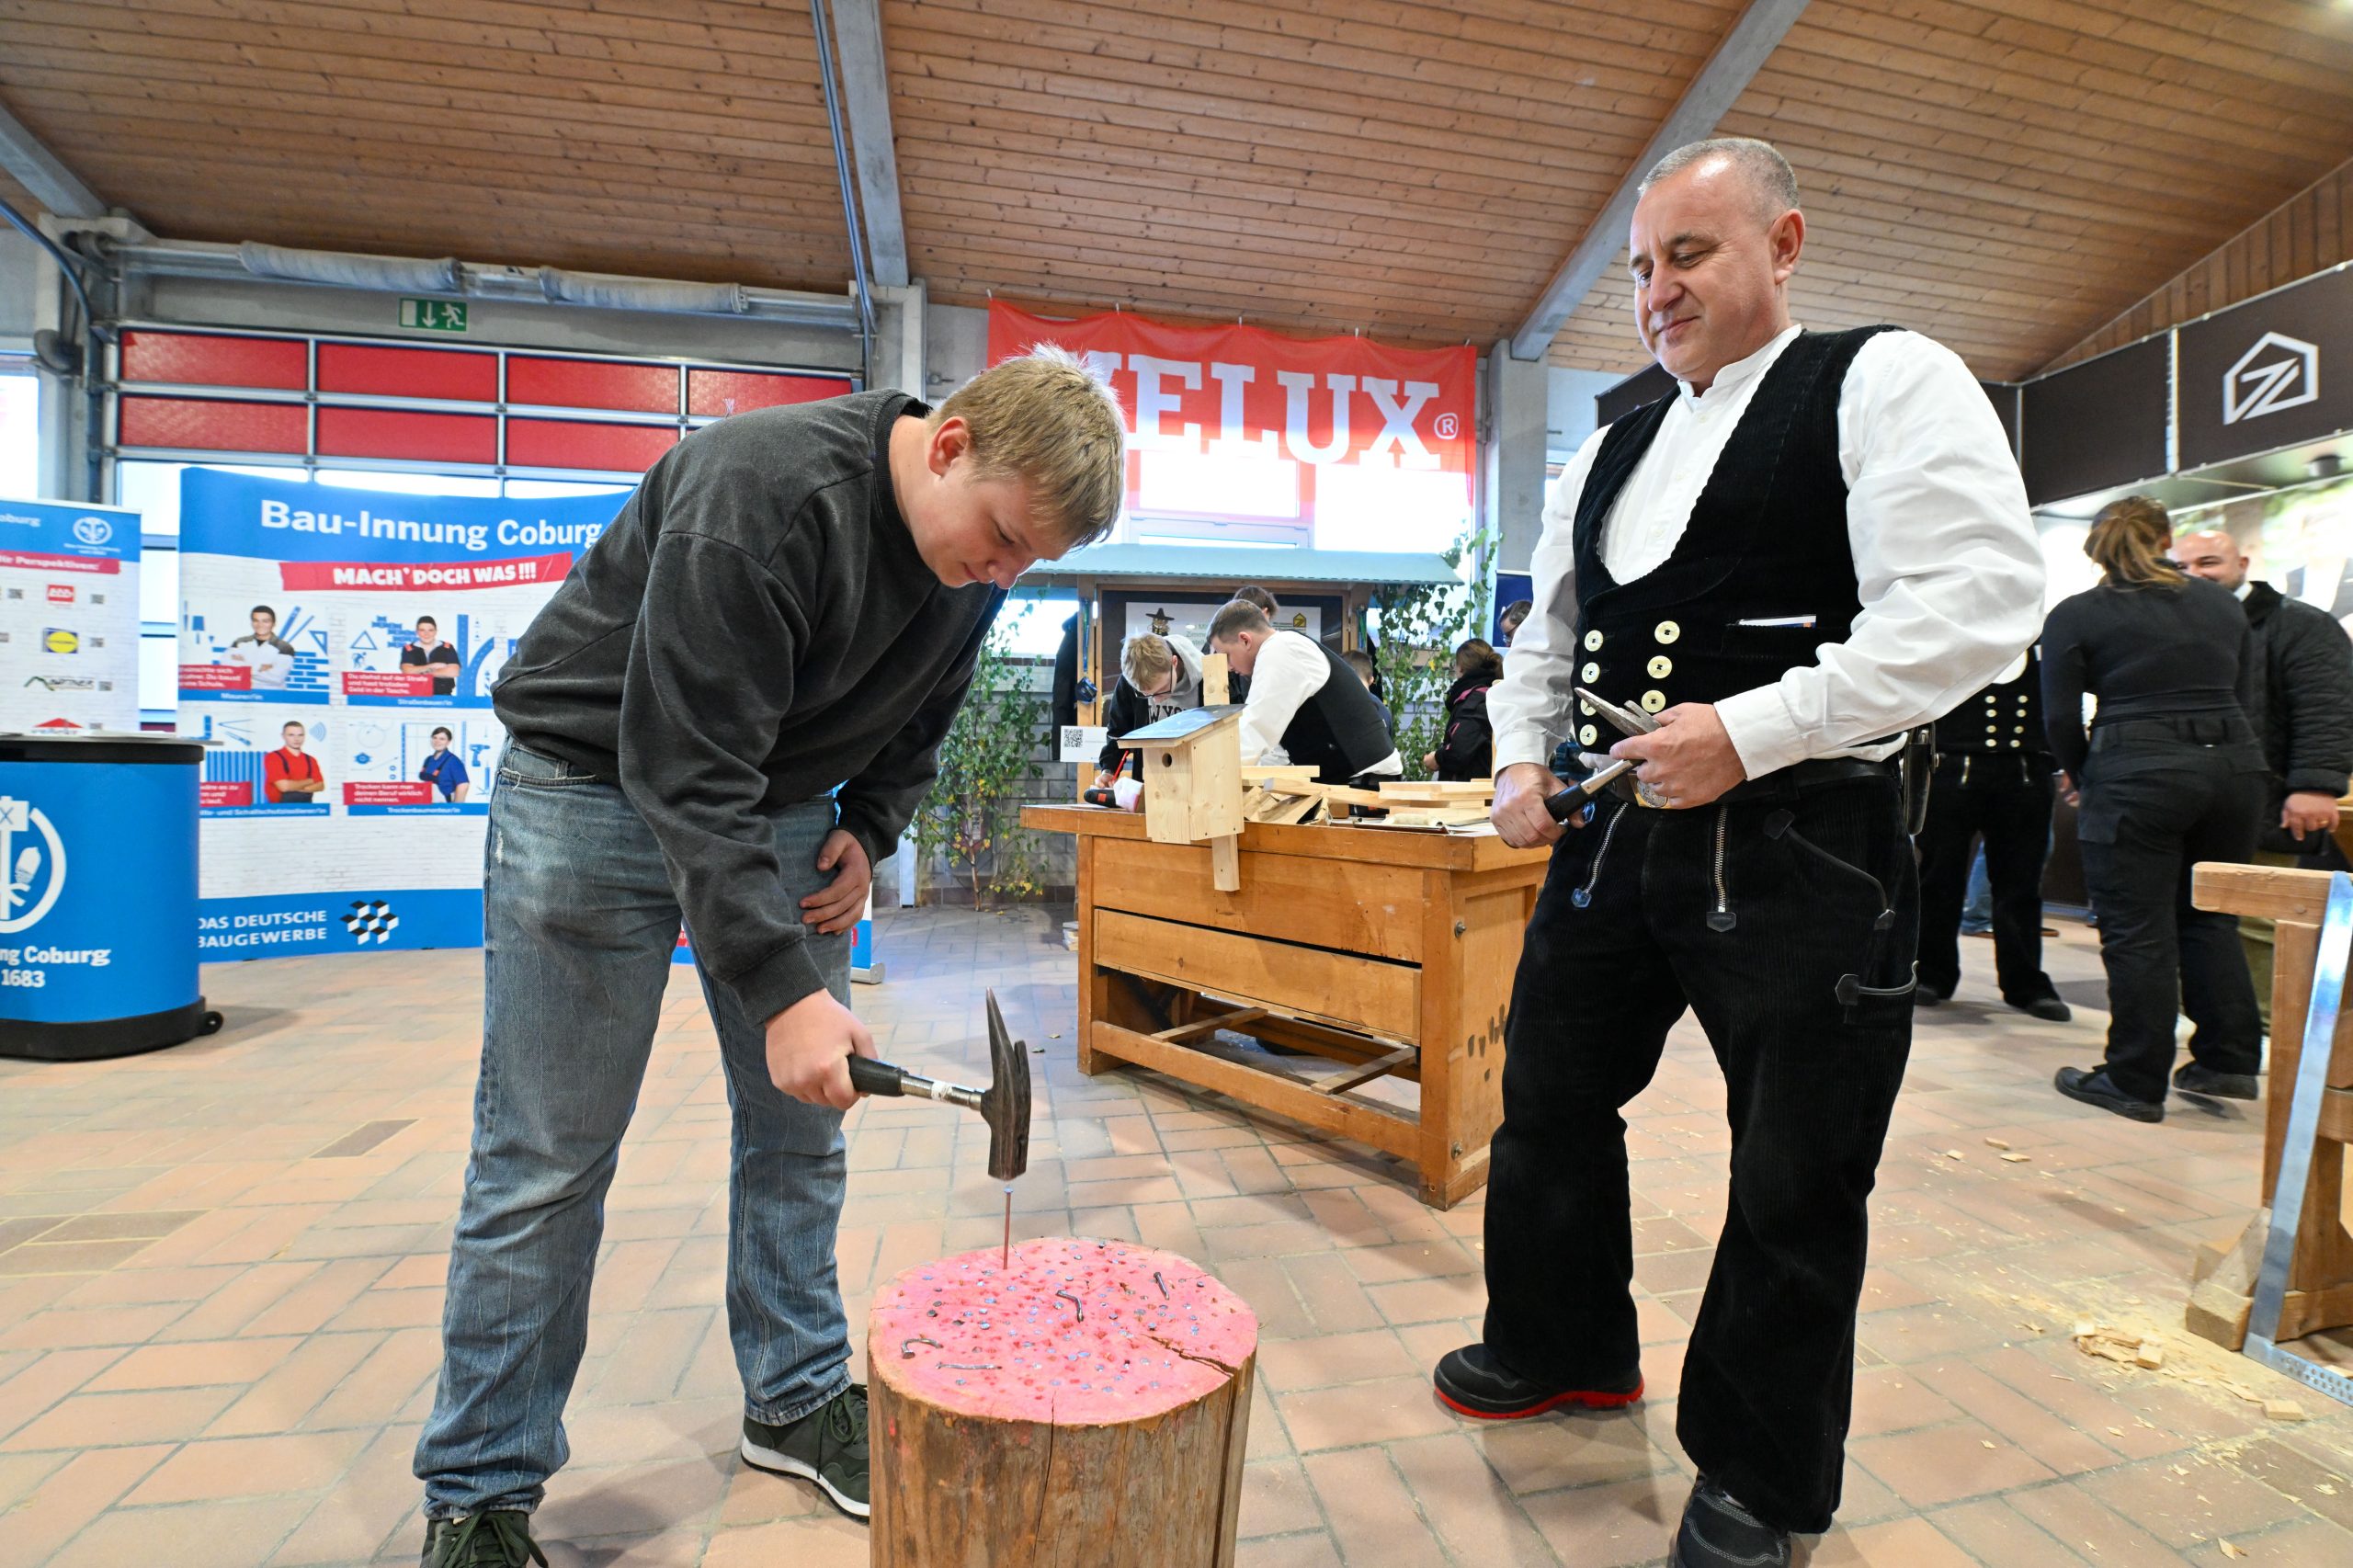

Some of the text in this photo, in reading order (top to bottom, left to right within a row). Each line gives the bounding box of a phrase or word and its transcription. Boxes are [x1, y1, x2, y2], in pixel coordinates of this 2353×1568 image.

[0, 514, 40, 528] oburg
[261, 499, 602, 551] Bau-Innung Coburg
[413, 566, 471, 585] DOCH
[472, 564, 516, 583] WAS
[233, 910, 327, 928] DEUTSCHE
[23, 945, 112, 967] Coburg
[1, 968, 46, 988] 1683
